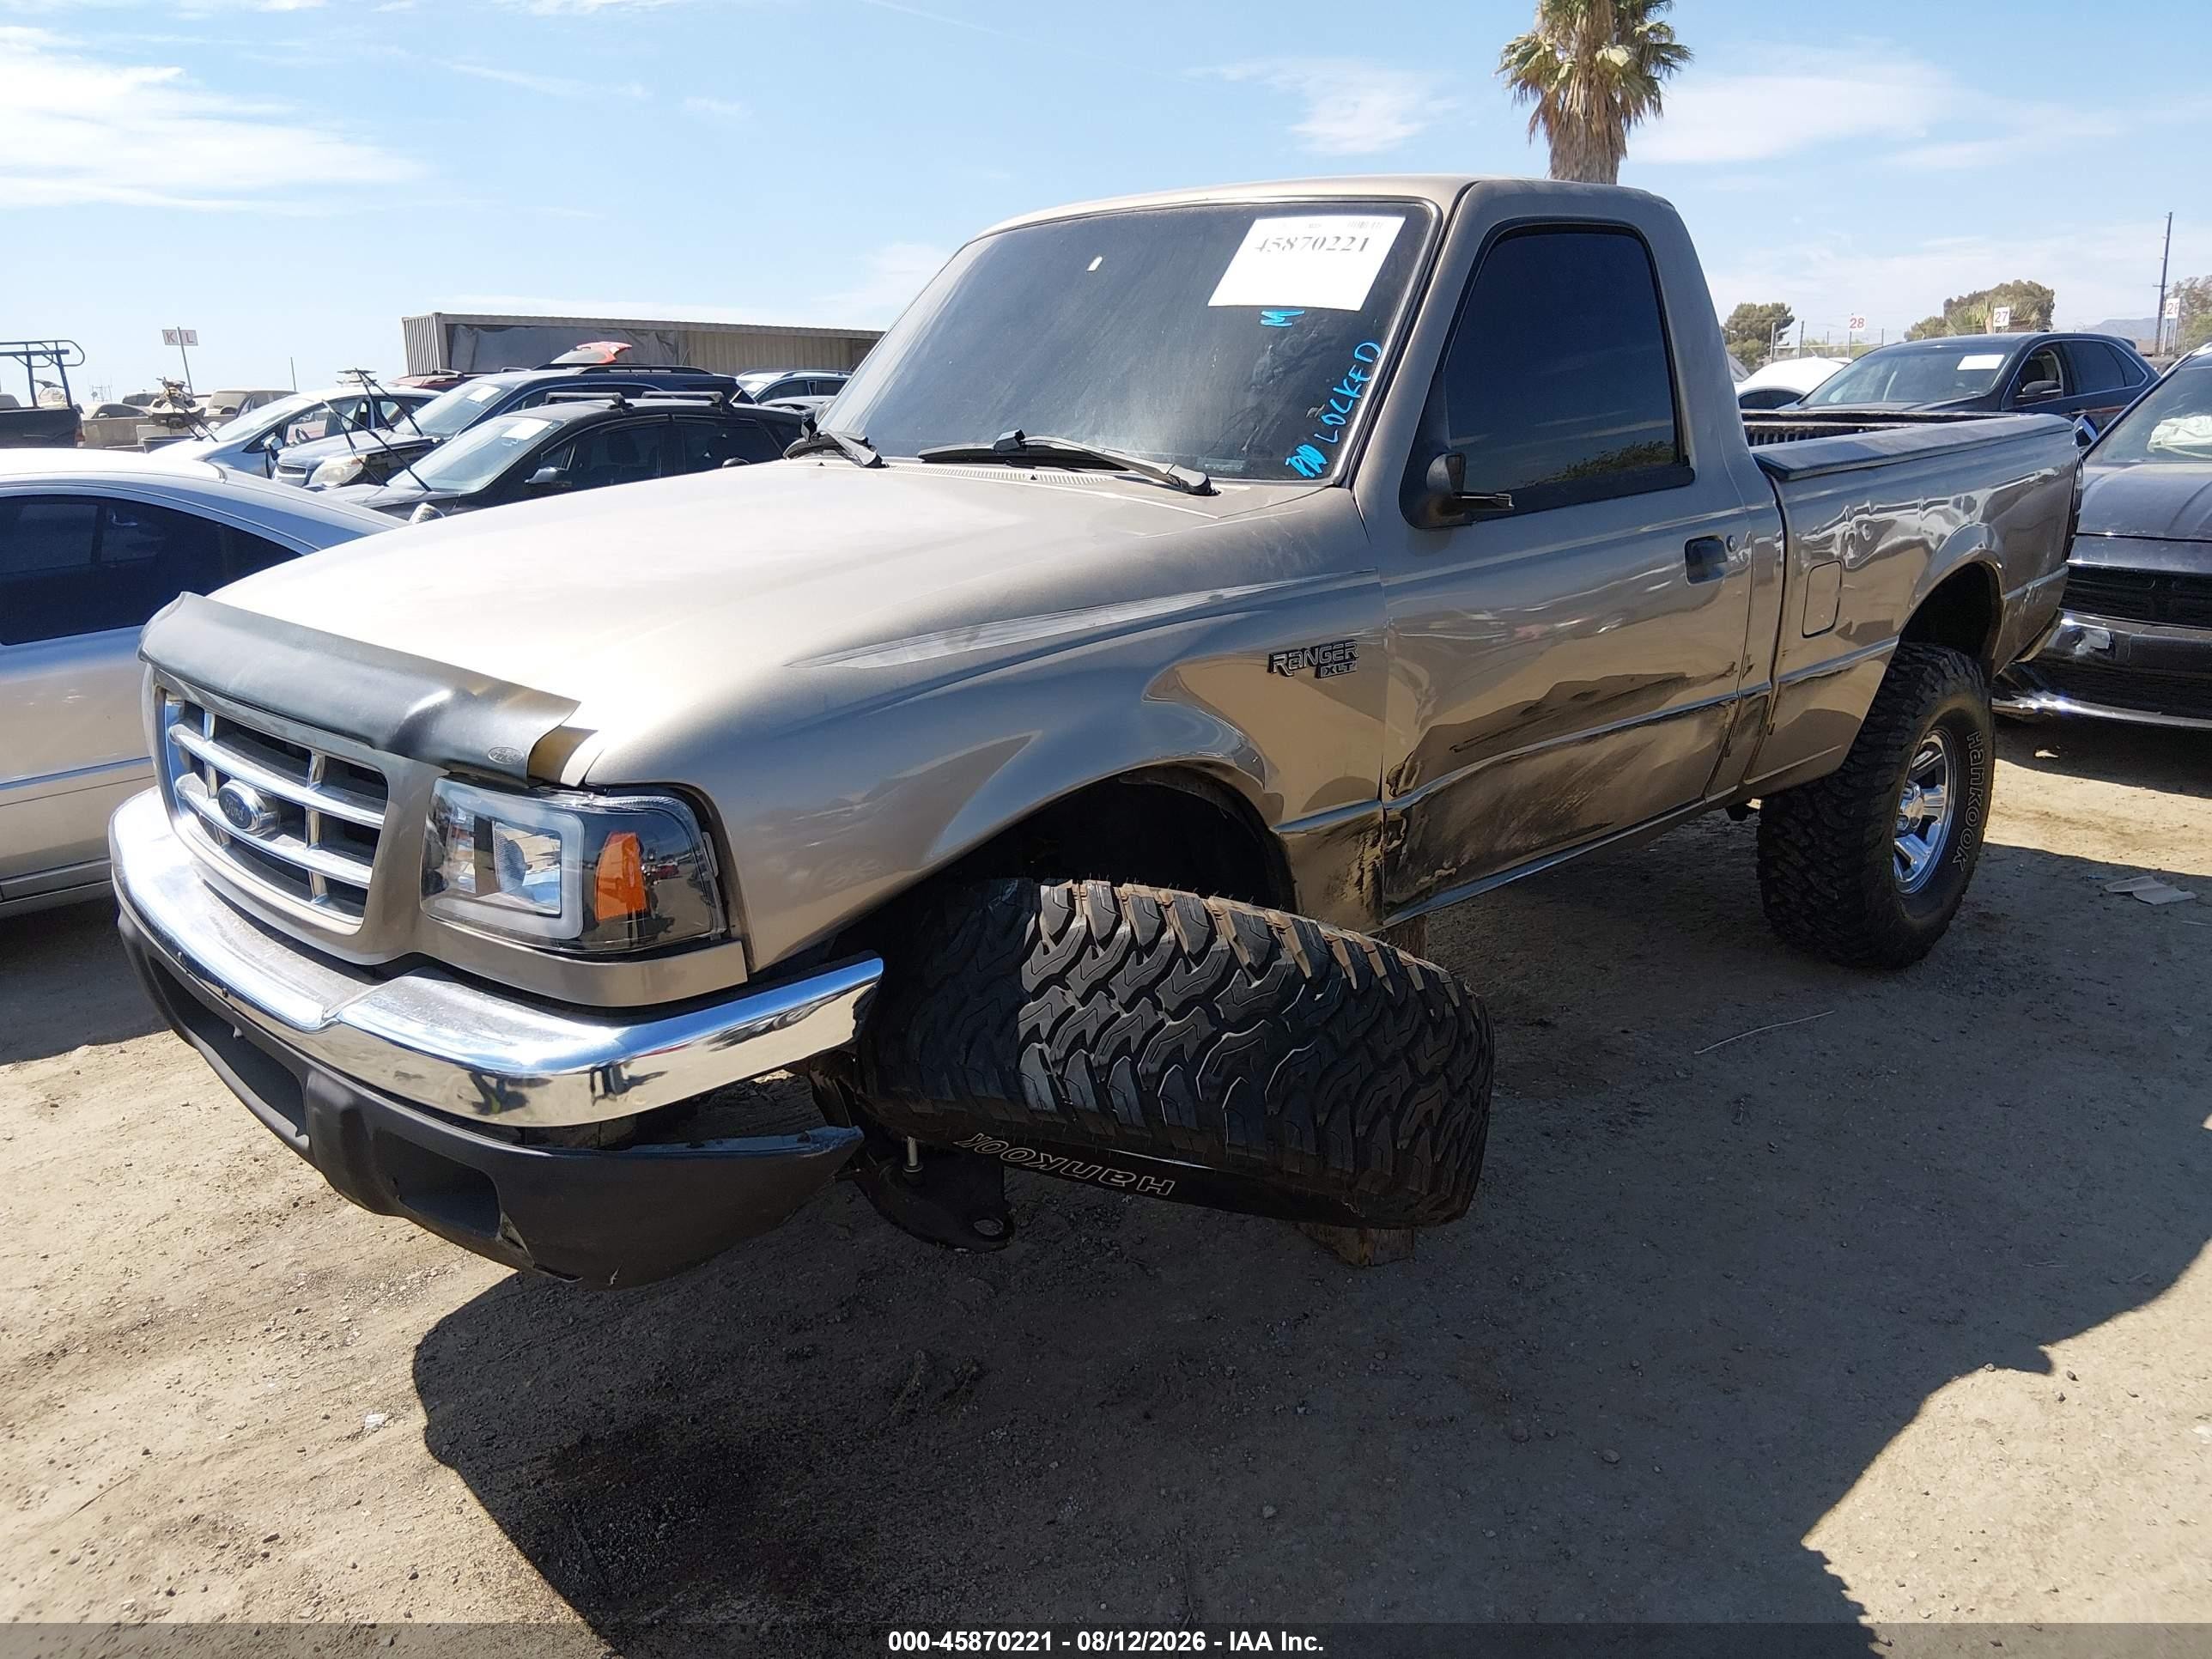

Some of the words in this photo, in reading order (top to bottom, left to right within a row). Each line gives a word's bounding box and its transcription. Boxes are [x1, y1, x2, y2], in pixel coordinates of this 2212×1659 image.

[1255, 236, 1370, 252] 45870221
[1849, 318, 1865, 329] 28
[1994, 311, 2008, 324] 27
[166, 331, 175, 343] K
[185, 331, 195, 343] L
[1314, 341, 1383, 444] LOCKED
[1324, 662, 1354, 676] XLT
